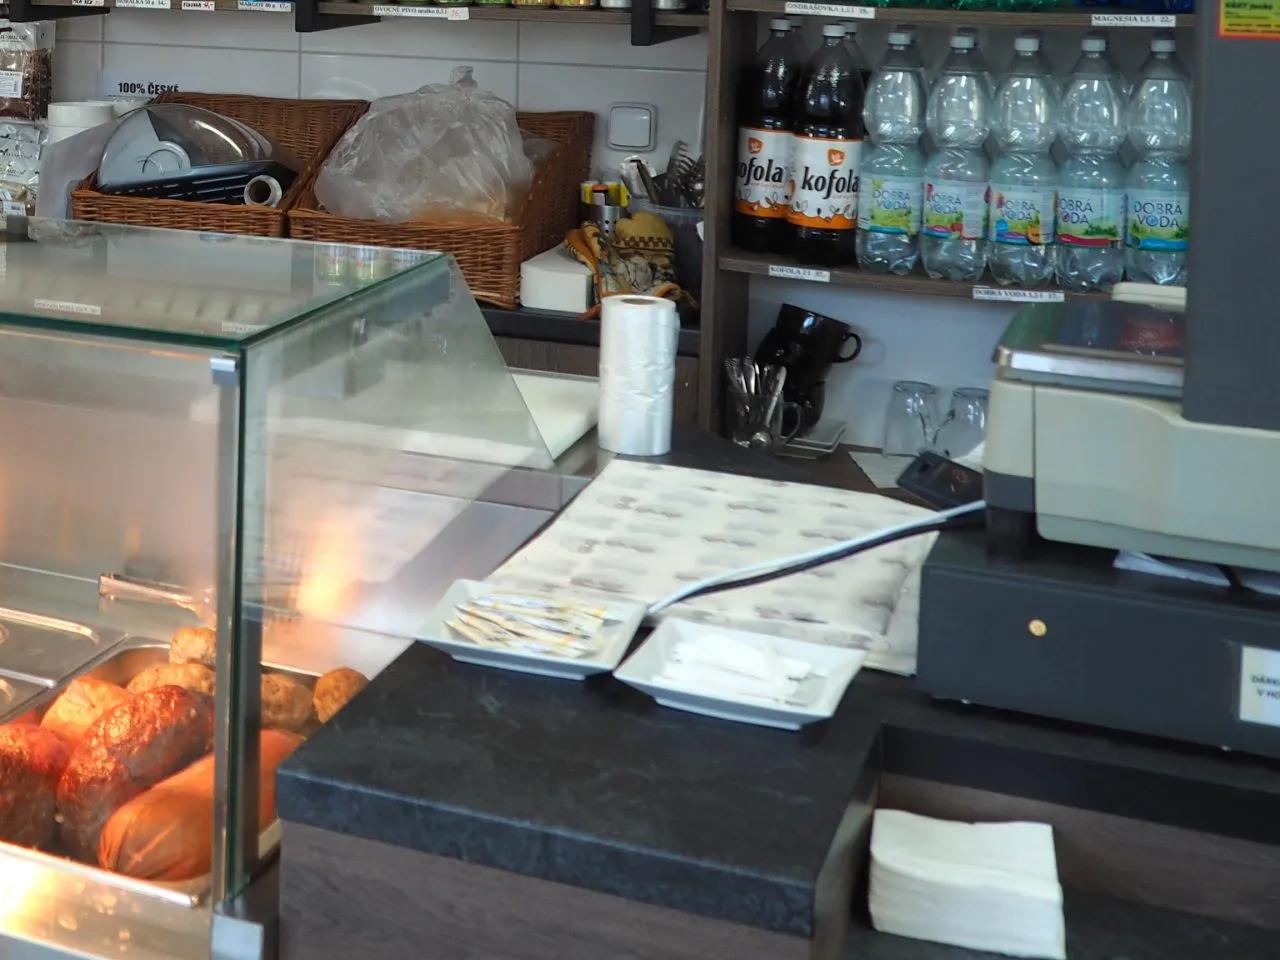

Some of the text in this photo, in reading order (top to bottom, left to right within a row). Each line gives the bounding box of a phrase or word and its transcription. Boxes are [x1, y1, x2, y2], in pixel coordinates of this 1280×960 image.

[1093, 15, 1138, 24] MAGNESIA
[117, 82, 145, 94] 100%
[739, 157, 784, 186] ofola
[801, 166, 860, 200] kofola
[1134, 200, 1183, 216] DOBRÁ
[1137, 214, 1180, 228] VODA
